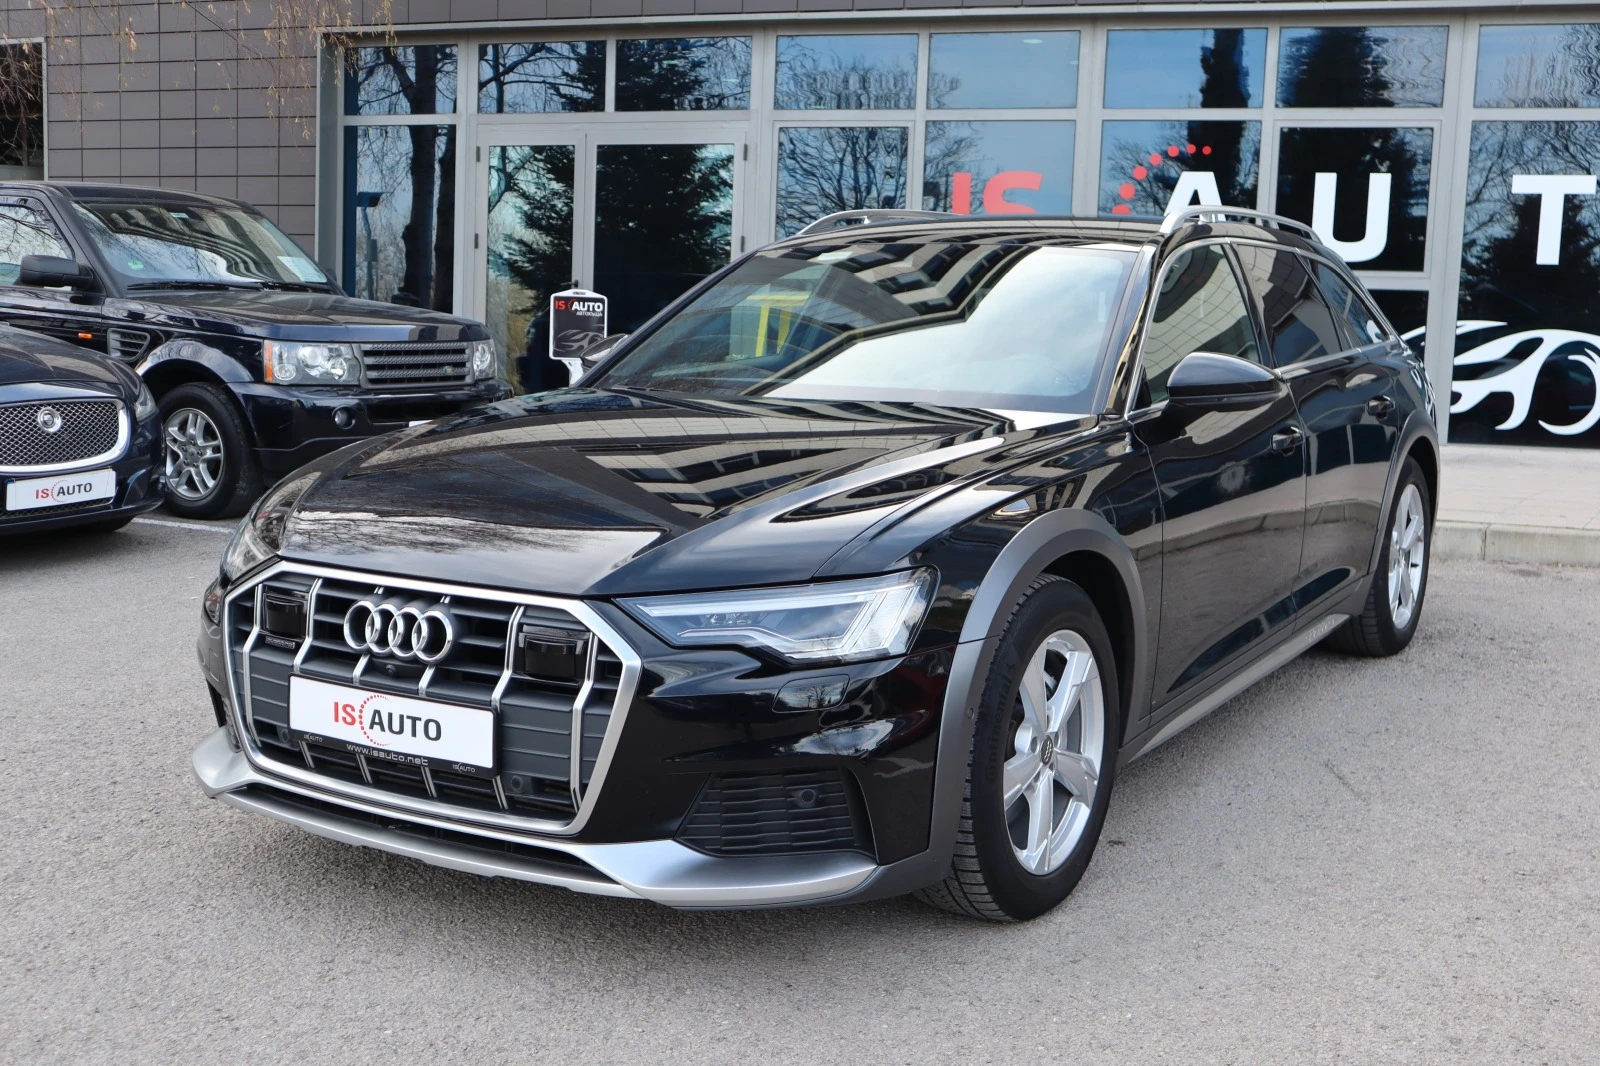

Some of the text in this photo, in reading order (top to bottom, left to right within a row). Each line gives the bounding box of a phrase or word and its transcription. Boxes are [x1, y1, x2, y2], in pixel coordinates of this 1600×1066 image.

[555, 300, 603, 311] IS AUTO
[35, 482, 92, 499] IS AUTO
[333, 701, 442, 742] IS AUTO
[346, 742, 429, 766] www.isauto.net
